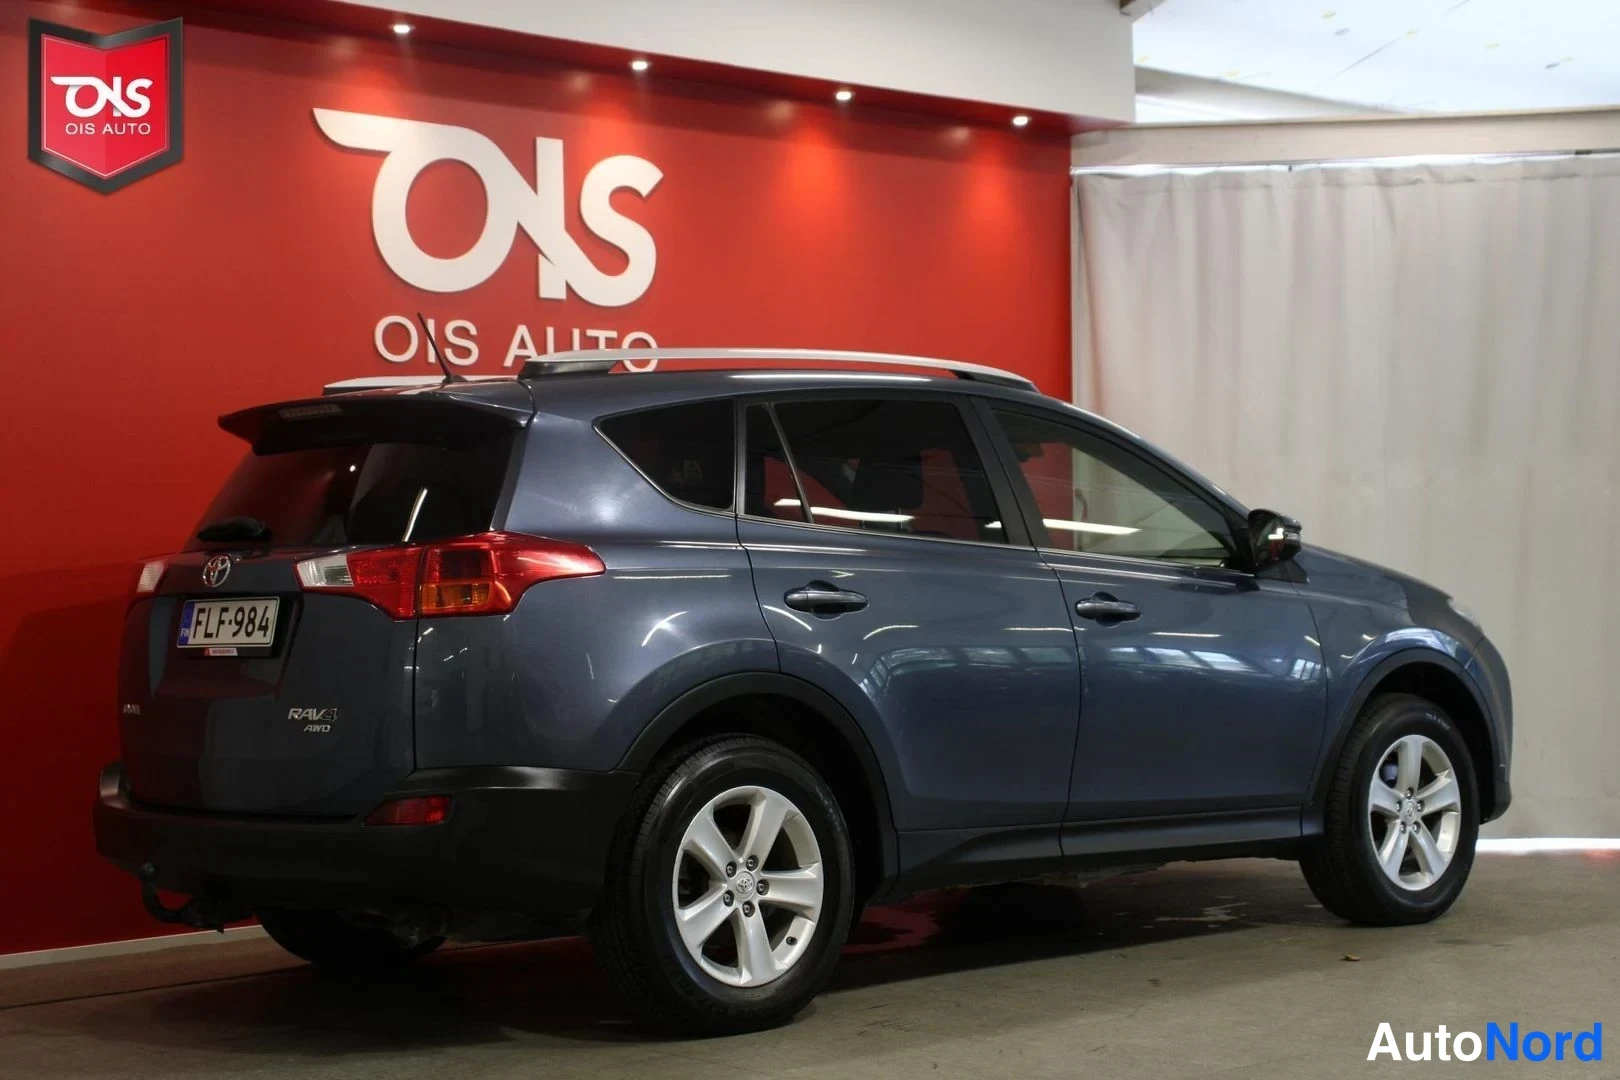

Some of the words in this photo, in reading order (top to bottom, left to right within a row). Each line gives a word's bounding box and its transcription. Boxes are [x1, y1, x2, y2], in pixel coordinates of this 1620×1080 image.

[312, 107, 664, 307] OIS
[374, 315, 480, 366] OIS
[193, 605, 269, 639] FLF-984
[287, 707, 338, 721] RAV4
[303, 724, 331, 732] AWD
